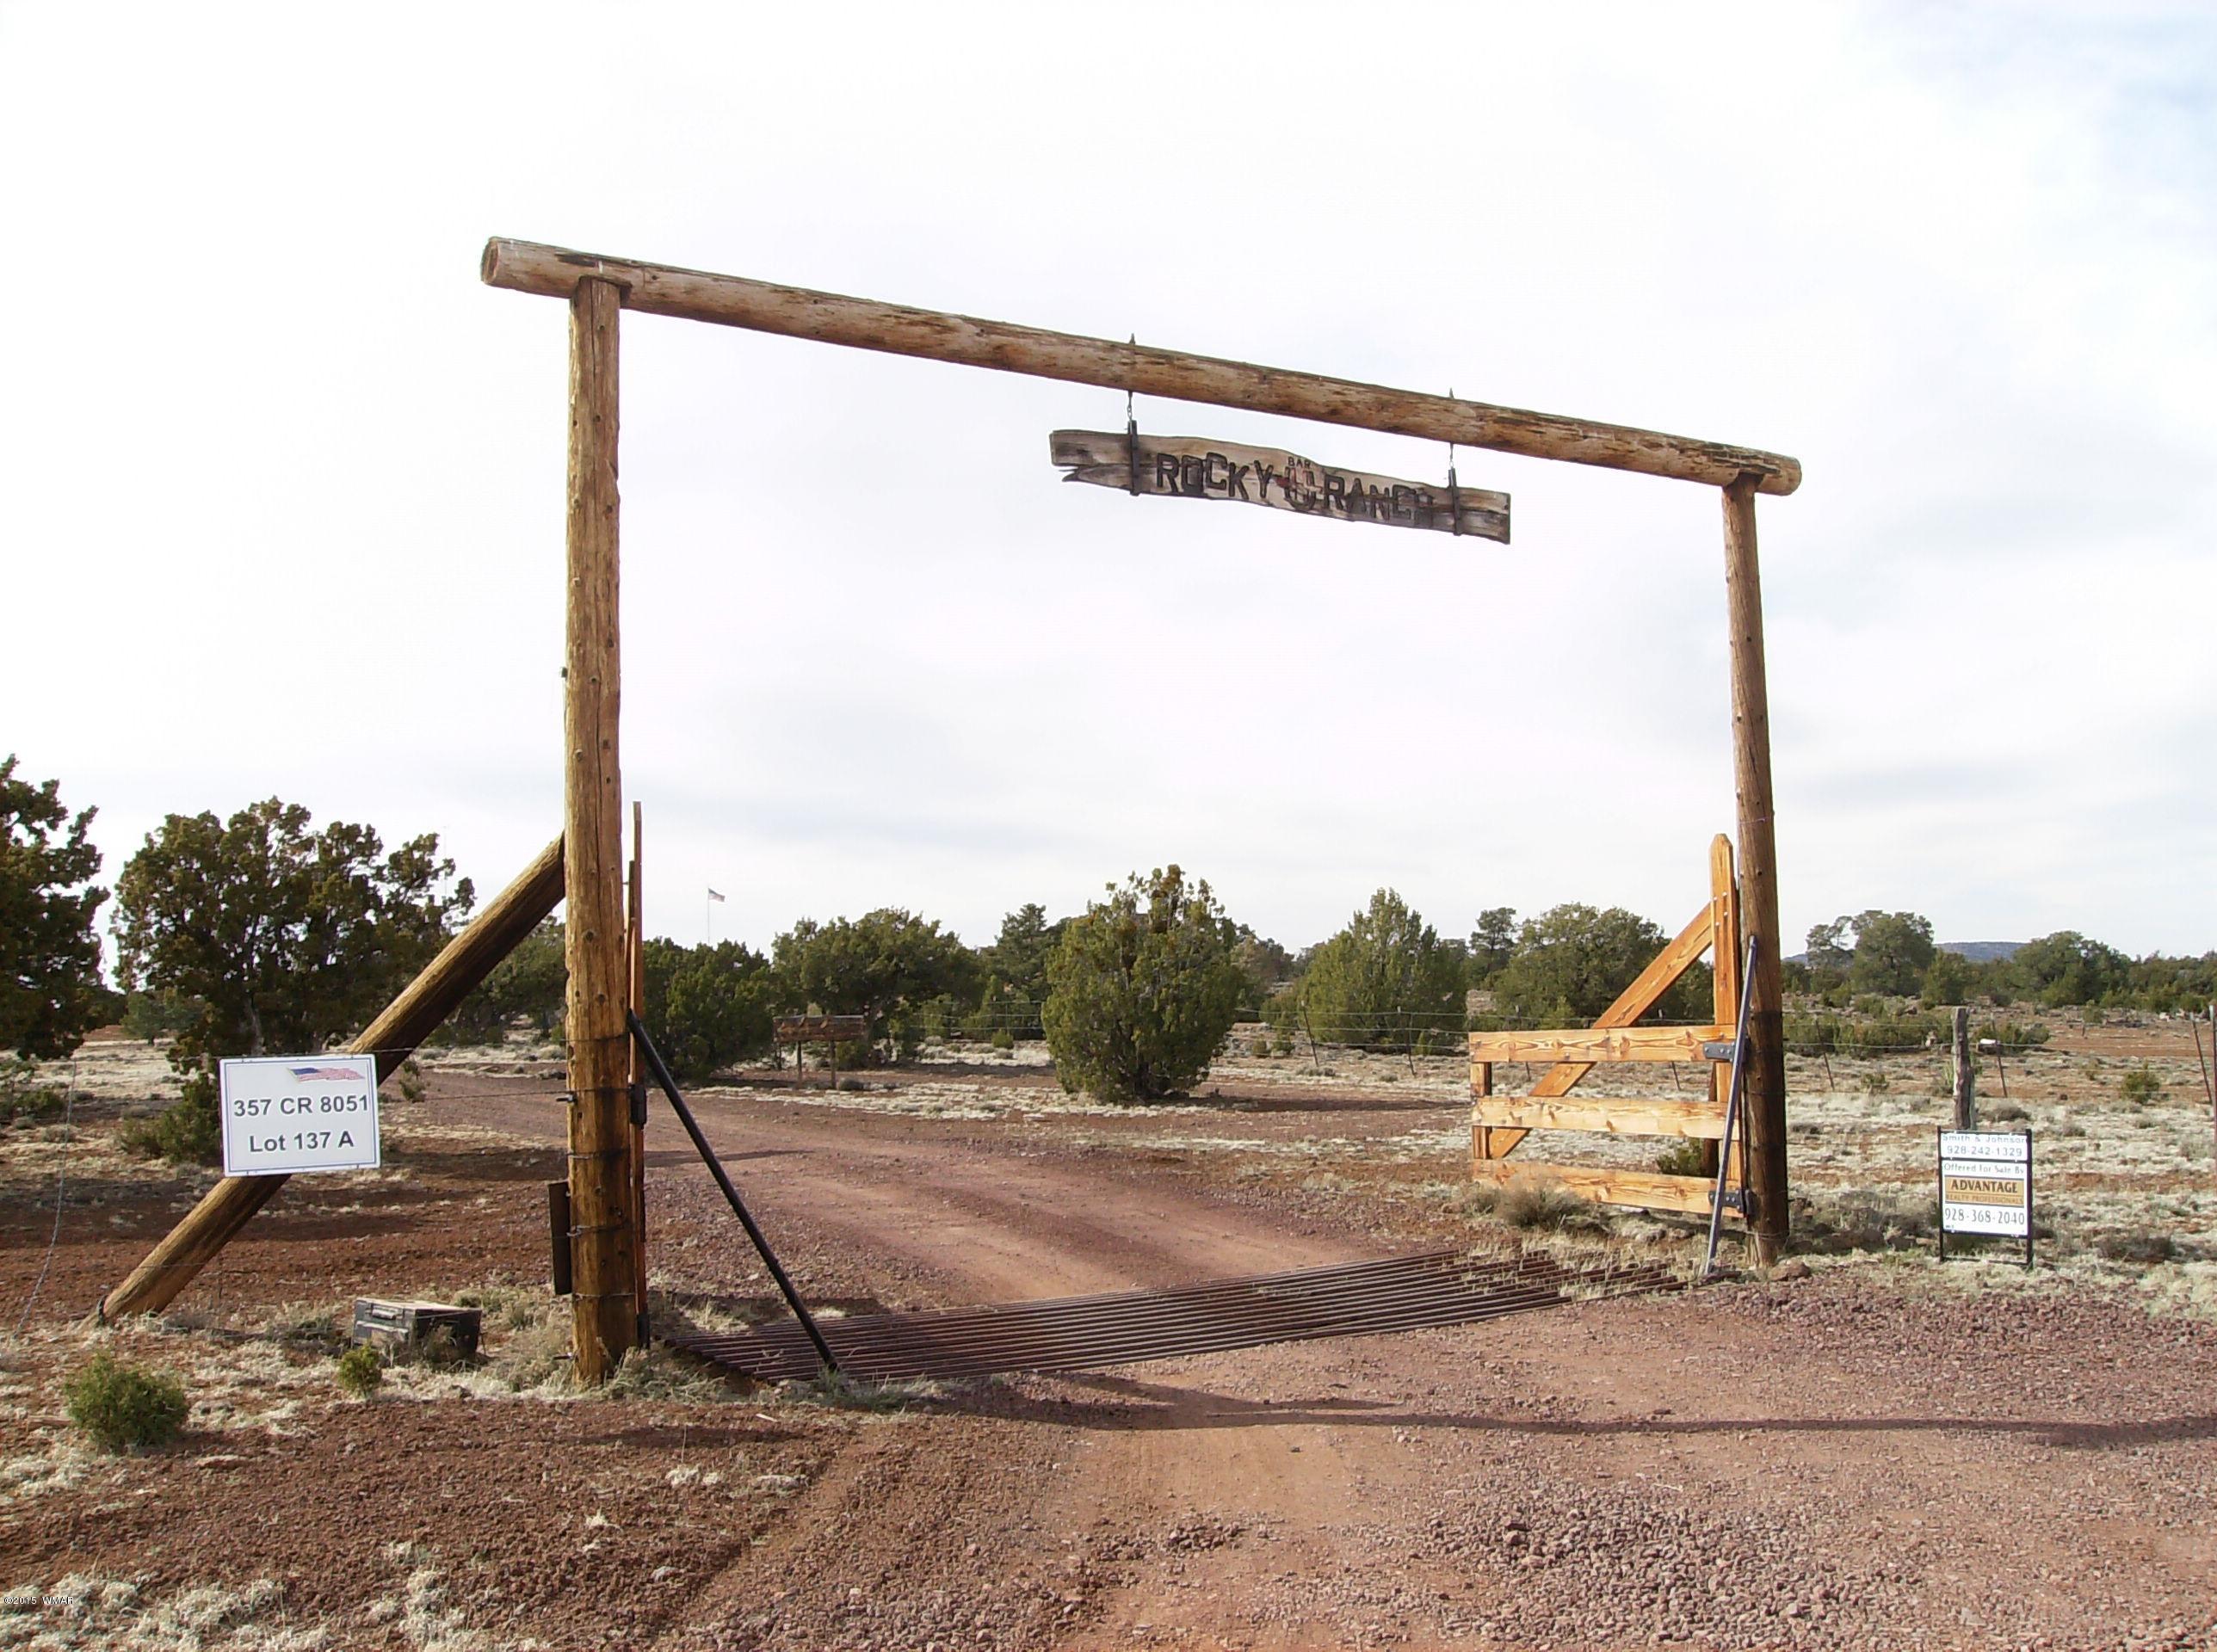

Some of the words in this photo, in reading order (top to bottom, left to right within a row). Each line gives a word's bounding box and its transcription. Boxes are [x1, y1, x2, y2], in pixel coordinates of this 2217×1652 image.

[1288, 456, 1311, 470] BAR
[1157, 451, 1274, 500] ROCKY
[1323, 474, 1435, 527] RANCH
[234, 1099, 272, 1117] 357
[280, 1097, 312, 1115] CR
[320, 1094, 368, 1113] 8051
[250, 1135, 286, 1152] Lot
[293, 1131, 331, 1150] 137
[338, 1131, 355, 1148] A
[1947, 1145, 2022, 1156] 928-242-1329
[1943, 1162, 1976, 1172] Offered
[1951, 1180, 2018, 1193] ADVANTAGE
[1945, 1208, 2025, 1225] 928-368-2040
